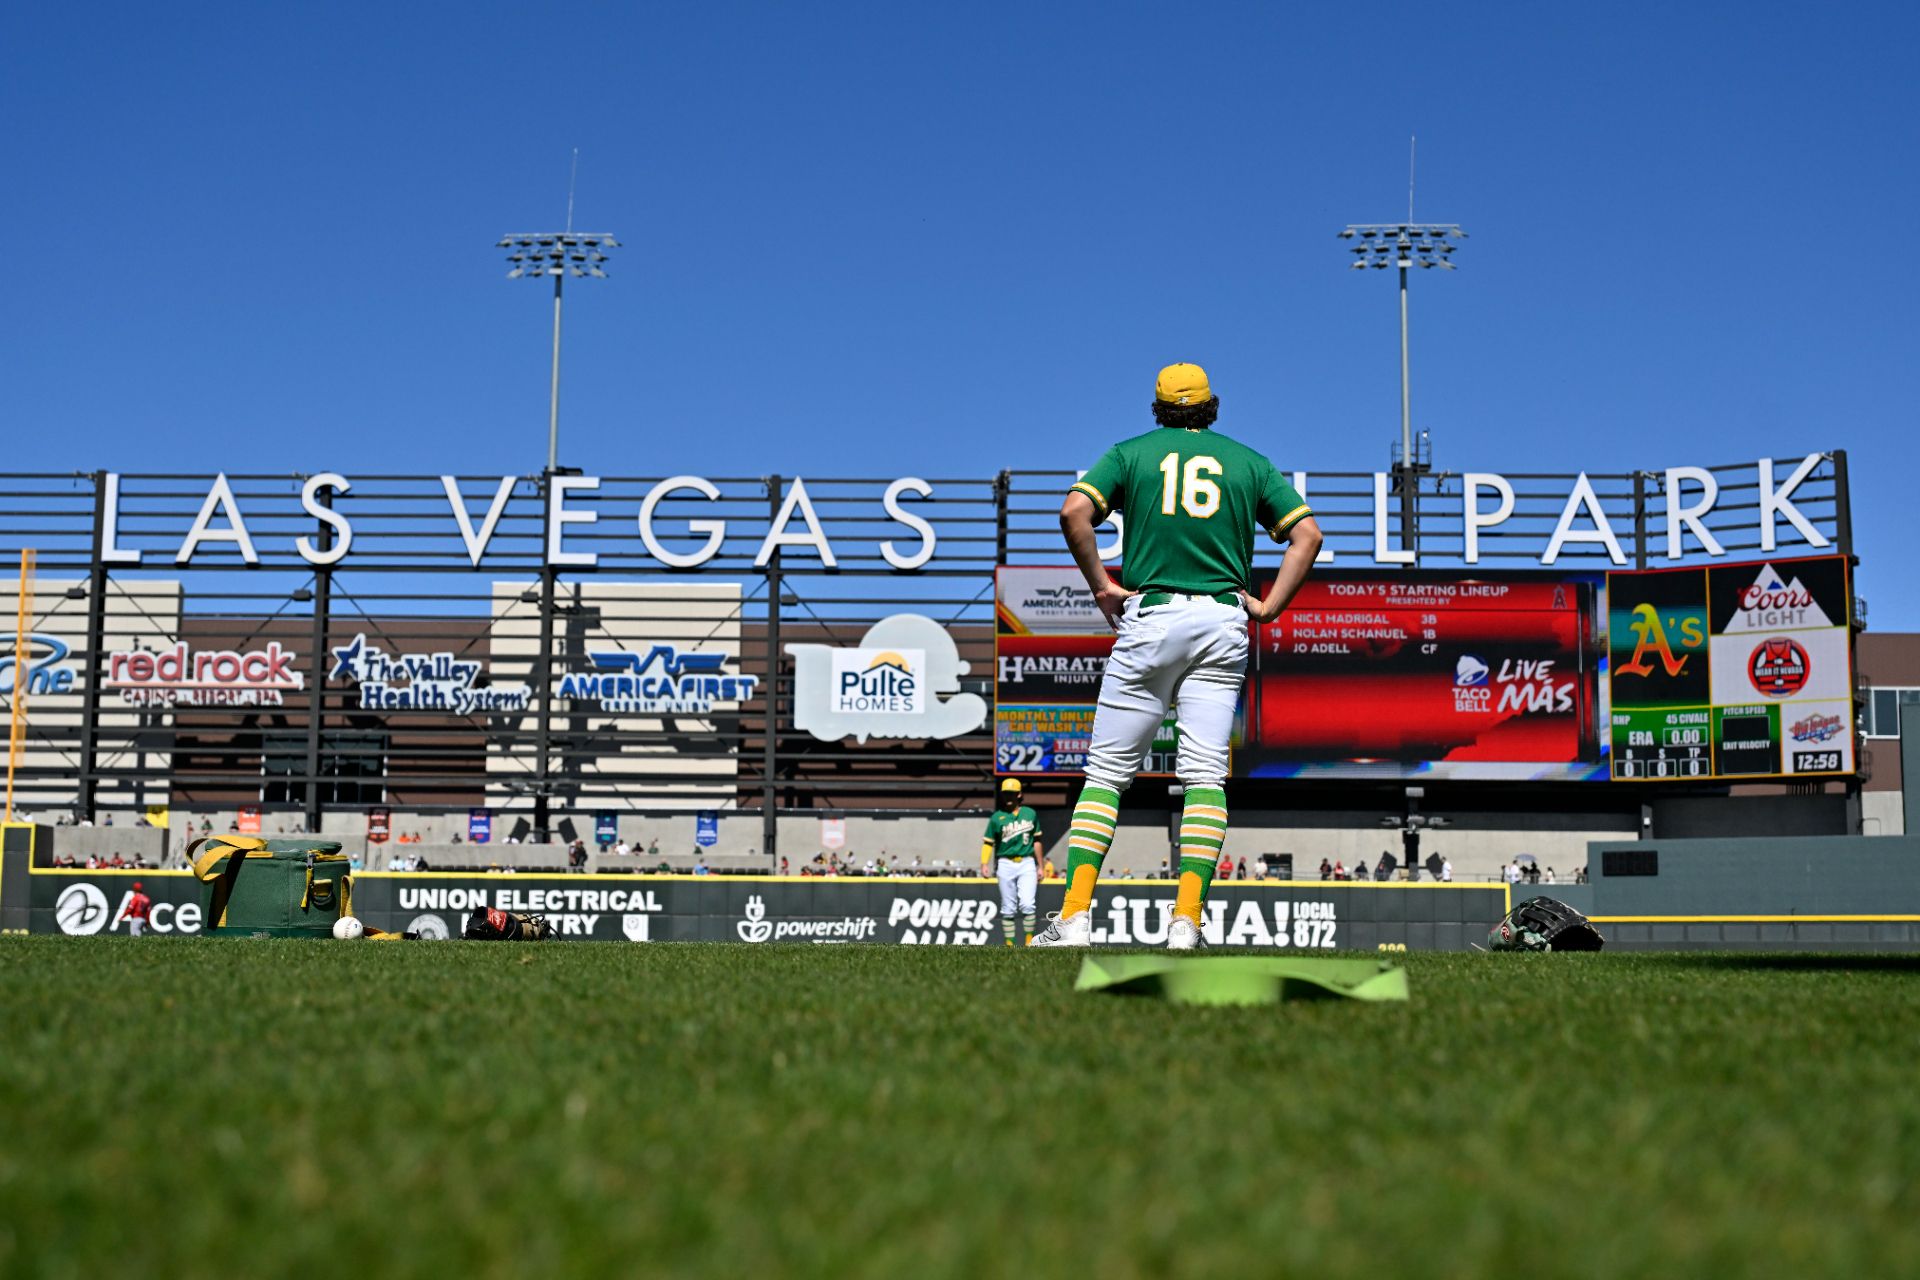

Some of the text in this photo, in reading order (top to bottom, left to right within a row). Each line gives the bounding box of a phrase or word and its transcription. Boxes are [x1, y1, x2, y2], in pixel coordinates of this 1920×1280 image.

[1160, 452, 1223, 518] 16
[101, 472, 353, 565] LAS
[441, 475, 937, 569] VEGAS
[1328, 584, 1510, 597] TODAY'S STARTING LINEUP
[1736, 583, 1814, 612] Coors
[1022, 599, 1099, 609] AMERICA FIRS
[1386, 597, 1451, 605] PRESENTED BY
[1293, 613, 1322, 624] NICK
[1325, 613, 1390, 624] MADRIGAL
[1747, 609, 1806, 628] LIGHT
[1293, 628, 1338, 639] NOLAN
[1341, 629, 1408, 640] SCHANUEL
[1273, 643, 1438, 654] 7 JO ADELL CF
[111, 645, 293, 683] red rock
[365, 650, 479, 688] The Valley
[998, 656, 1110, 683] HANRATT
[841, 668, 916, 697] Pulte
[1054, 674, 1097, 683] INJURY
[363, 683, 451, 709] Health
[559, 676, 756, 701] AMERICA FIRST
[1452, 687, 1491, 700] TACO
[840, 697, 915, 711] HOMES
[1455, 701, 1491, 713] BELL
[1723, 705, 1767, 716] PITCH SPEED
[997, 711, 1056, 721] MONTHLY
[1612, 712, 1709, 725] RHP 45 CIVALE
[1036, 722, 1072, 732] WASH
[1153, 726, 1174, 741] RA
[1628, 729, 1700, 746] ERA 0.00
[1722, 740, 1770, 750] EXIT VELOCITY
[998, 743, 1044, 771] $22
[1054, 753, 1083, 765] CAR
[1658, 748, 1666, 759] S
[1797, 753, 1838, 770] 12:58
[1624, 760, 1699, 777] 0 0 0
[399, 888, 663, 911] UNION ELECTRICAL
[887, 897, 998, 930] POWER
[1293, 901, 1336, 920] LOCAL
[774, 917, 877, 939] powershift
[1293, 920, 1337, 948] 872
